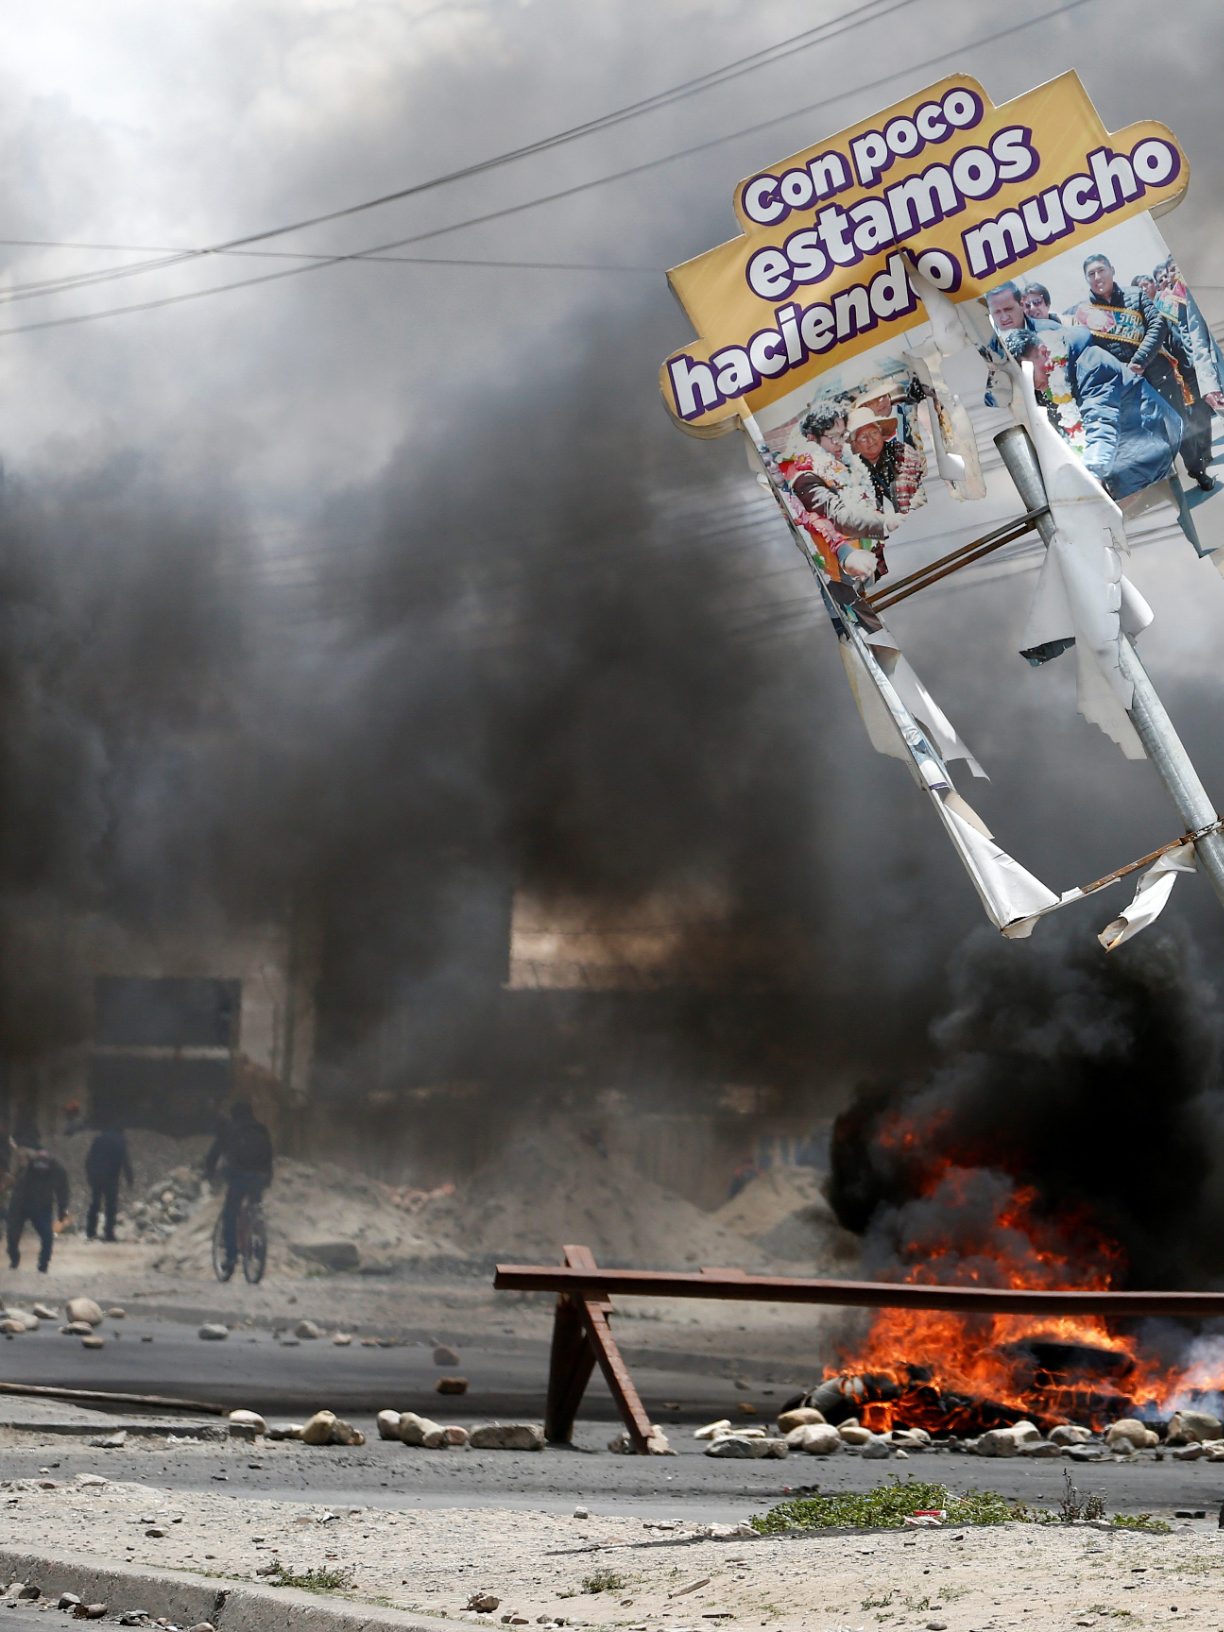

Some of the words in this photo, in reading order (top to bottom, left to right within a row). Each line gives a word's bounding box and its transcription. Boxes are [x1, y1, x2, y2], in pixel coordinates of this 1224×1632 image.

[742, 151, 850, 225] Con
[850, 86, 984, 189] poco
[746, 125, 1040, 300] estamos
[667, 247, 962, 420] haciendo
[963, 137, 1181, 280] mucho
